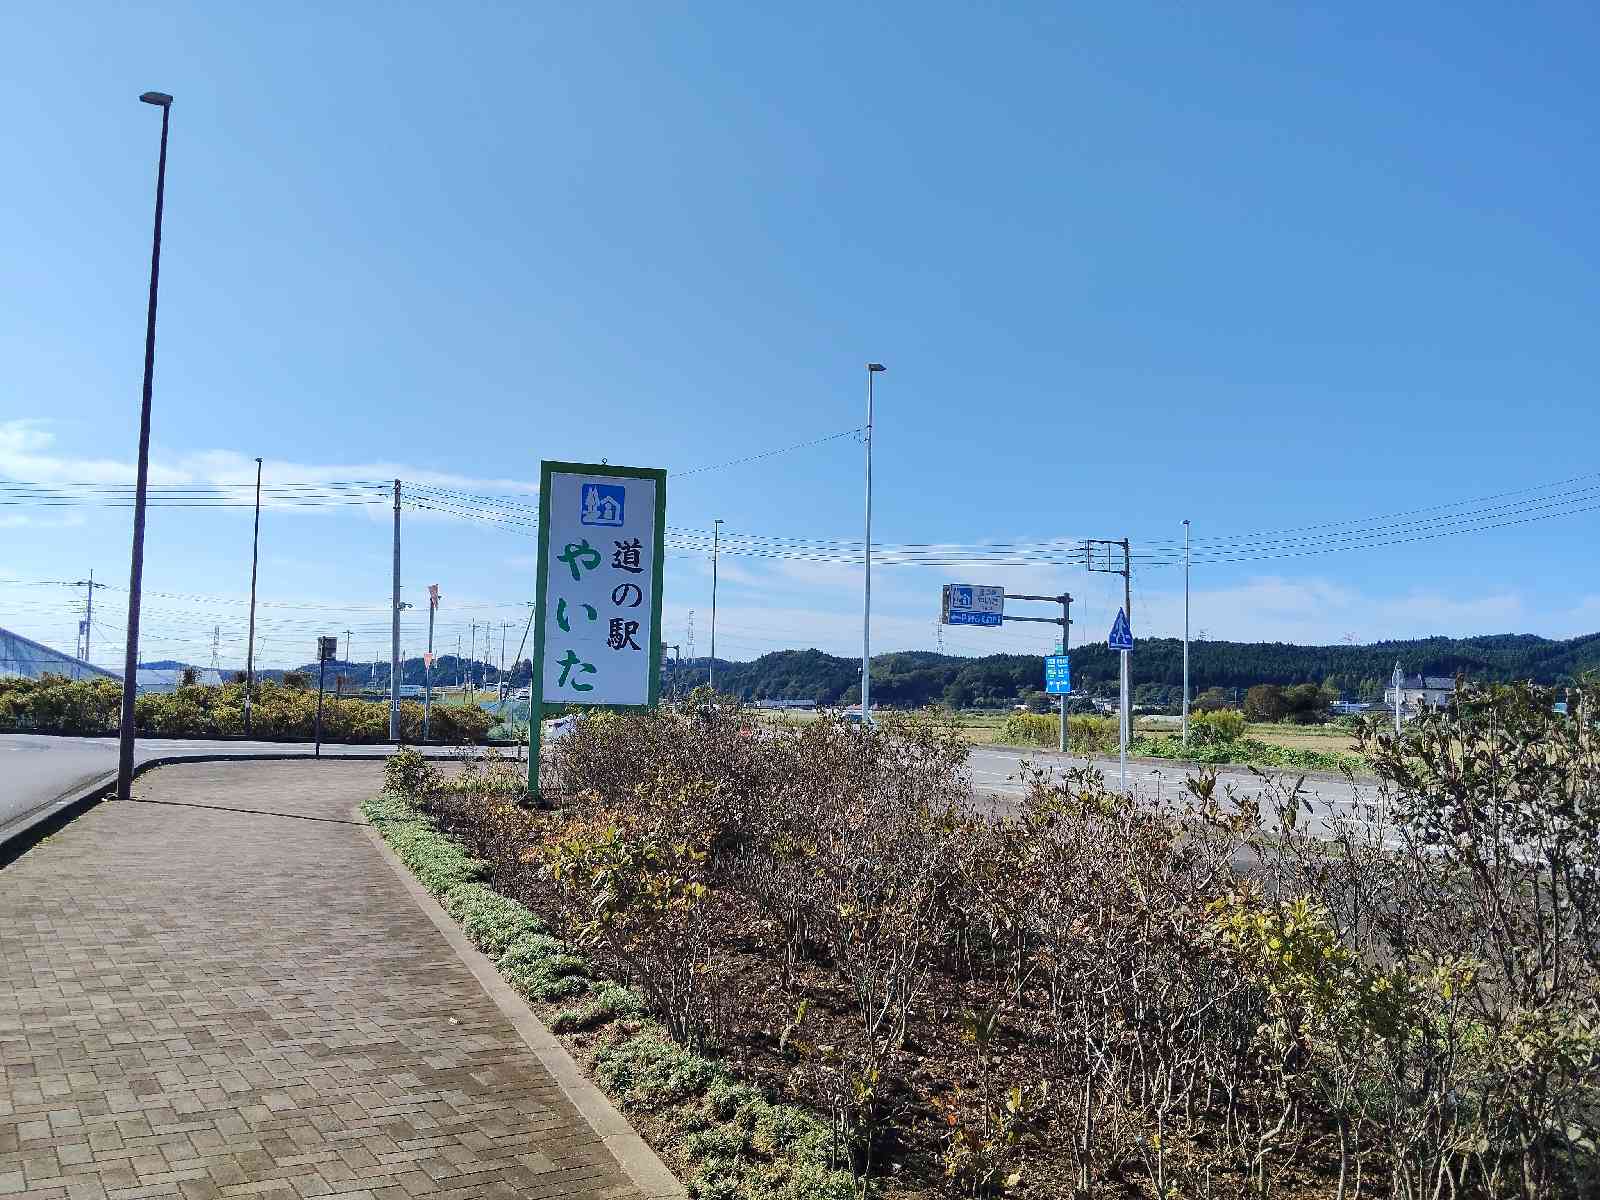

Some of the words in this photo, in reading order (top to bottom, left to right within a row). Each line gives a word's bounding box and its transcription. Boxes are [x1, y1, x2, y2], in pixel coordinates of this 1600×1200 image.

[556, 539, 602, 691] やいた
[607, 538, 645, 650] 道の駅
